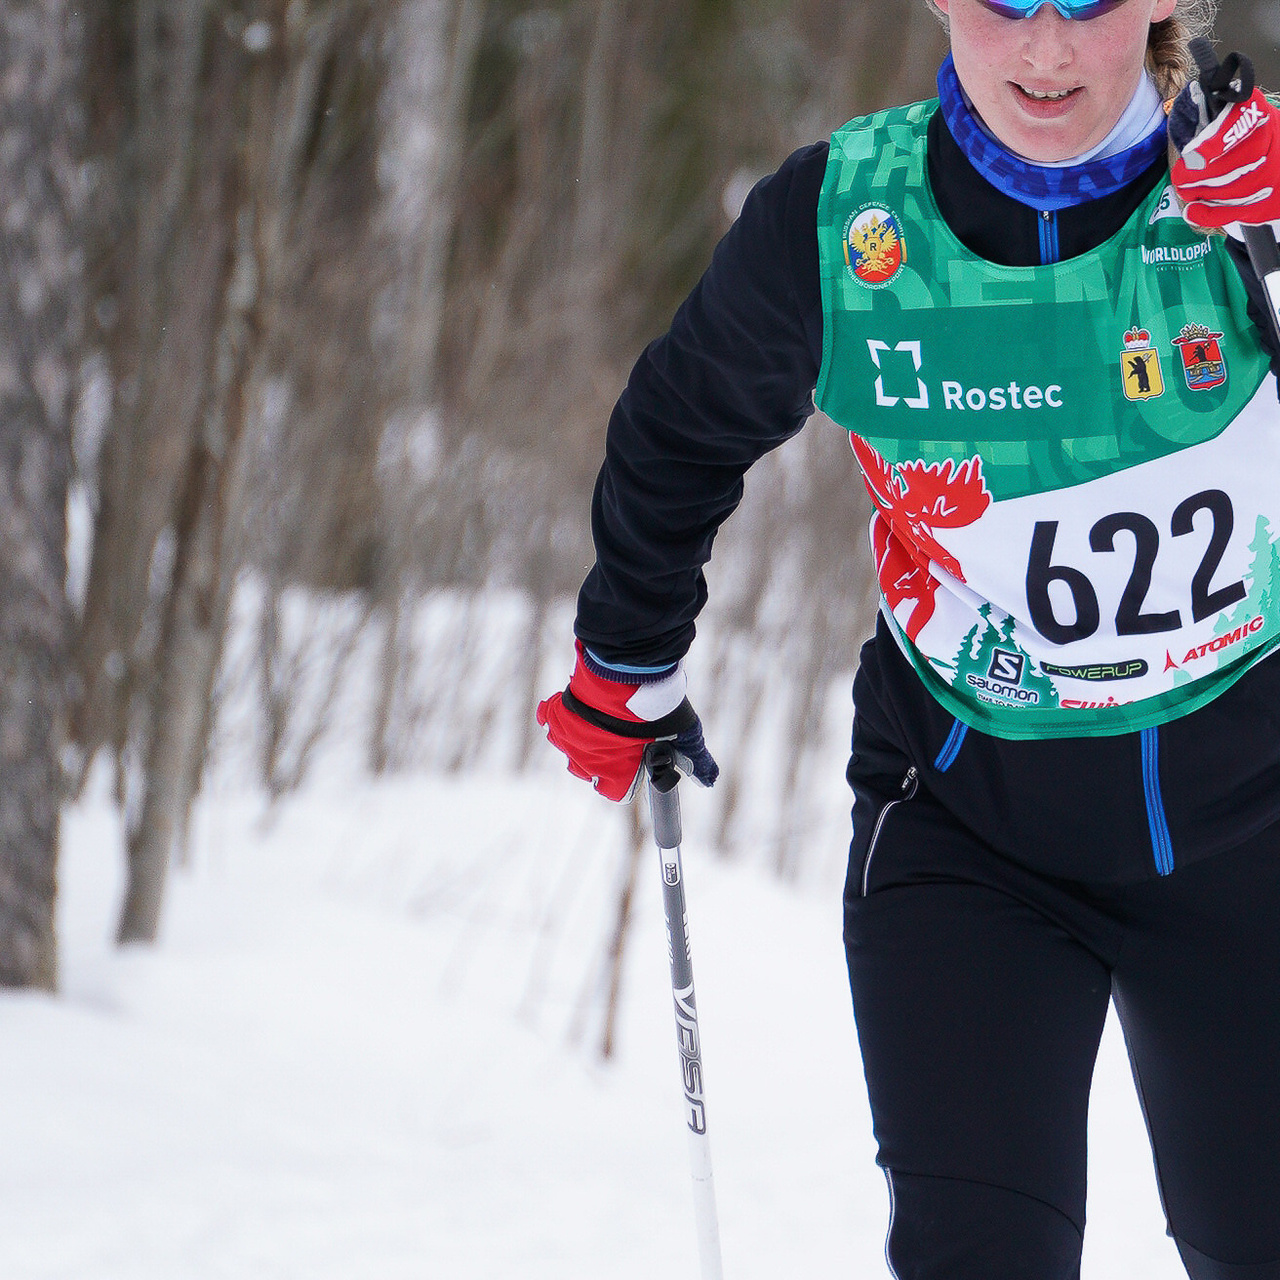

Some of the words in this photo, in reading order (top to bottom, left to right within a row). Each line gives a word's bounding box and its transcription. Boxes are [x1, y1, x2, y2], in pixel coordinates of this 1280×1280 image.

[941, 380, 1063, 411] Rostec
[1025, 488, 1248, 646] 622
[1181, 615, 1264, 665] ATOMIC
[1046, 662, 1142, 679] POWERUP
